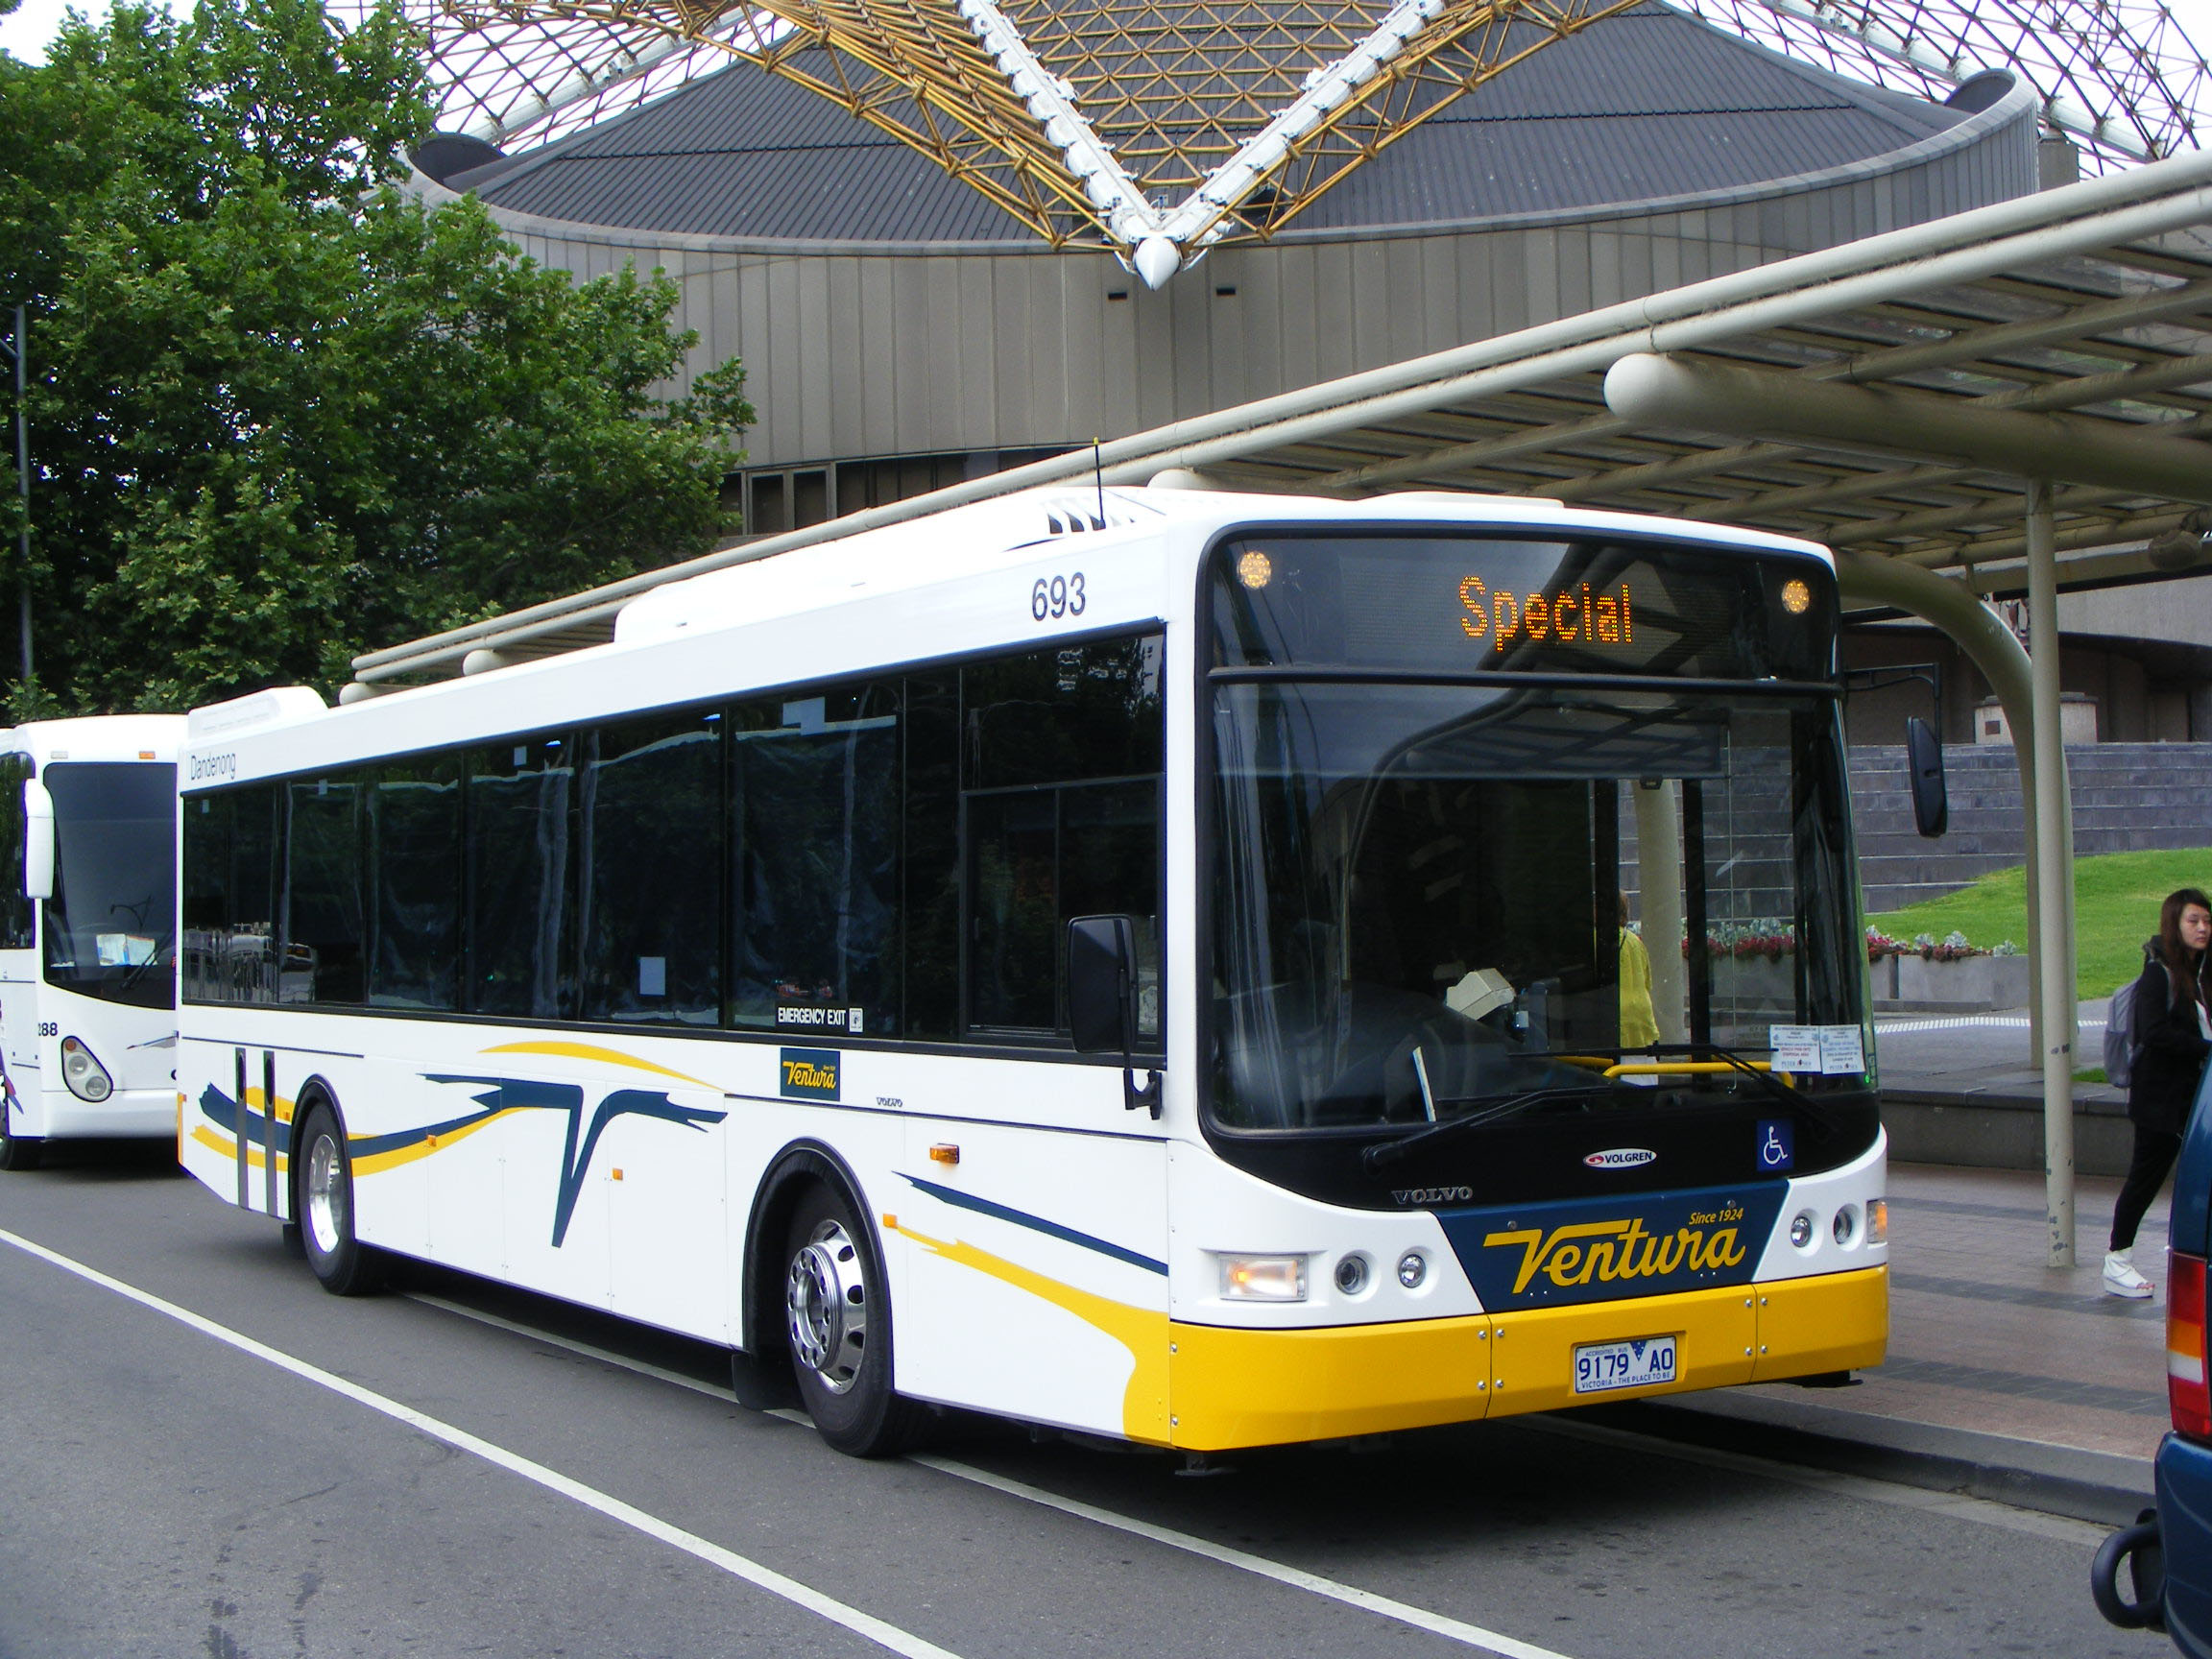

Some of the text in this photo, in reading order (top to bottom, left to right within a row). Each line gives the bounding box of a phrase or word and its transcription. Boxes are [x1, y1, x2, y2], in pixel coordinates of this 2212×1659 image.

[1032, 571, 1086, 621] 693
[1459, 576, 1632, 652] Special
[191, 753, 236, 781] Dandenong
[778, 1007, 847, 1025] EMERGENCY EXIT
[782, 1061, 837, 1089] Ventura
[876, 1096, 903, 1107] VOLVO
[1604, 1152, 1652, 1163] VOLGREN
[1391, 1186, 1474, 1204] VOLVO
[1689, 1207, 1743, 1225] Since 1924
[1483, 1218, 1745, 1293] Ventura
[1578, 1354, 1629, 1381] 9179
[1581, 1380, 1613, 1389] VICTORIA
[1618, 1376, 1630, 1384] THE
[1632, 1374, 1651, 1382] PLACE
